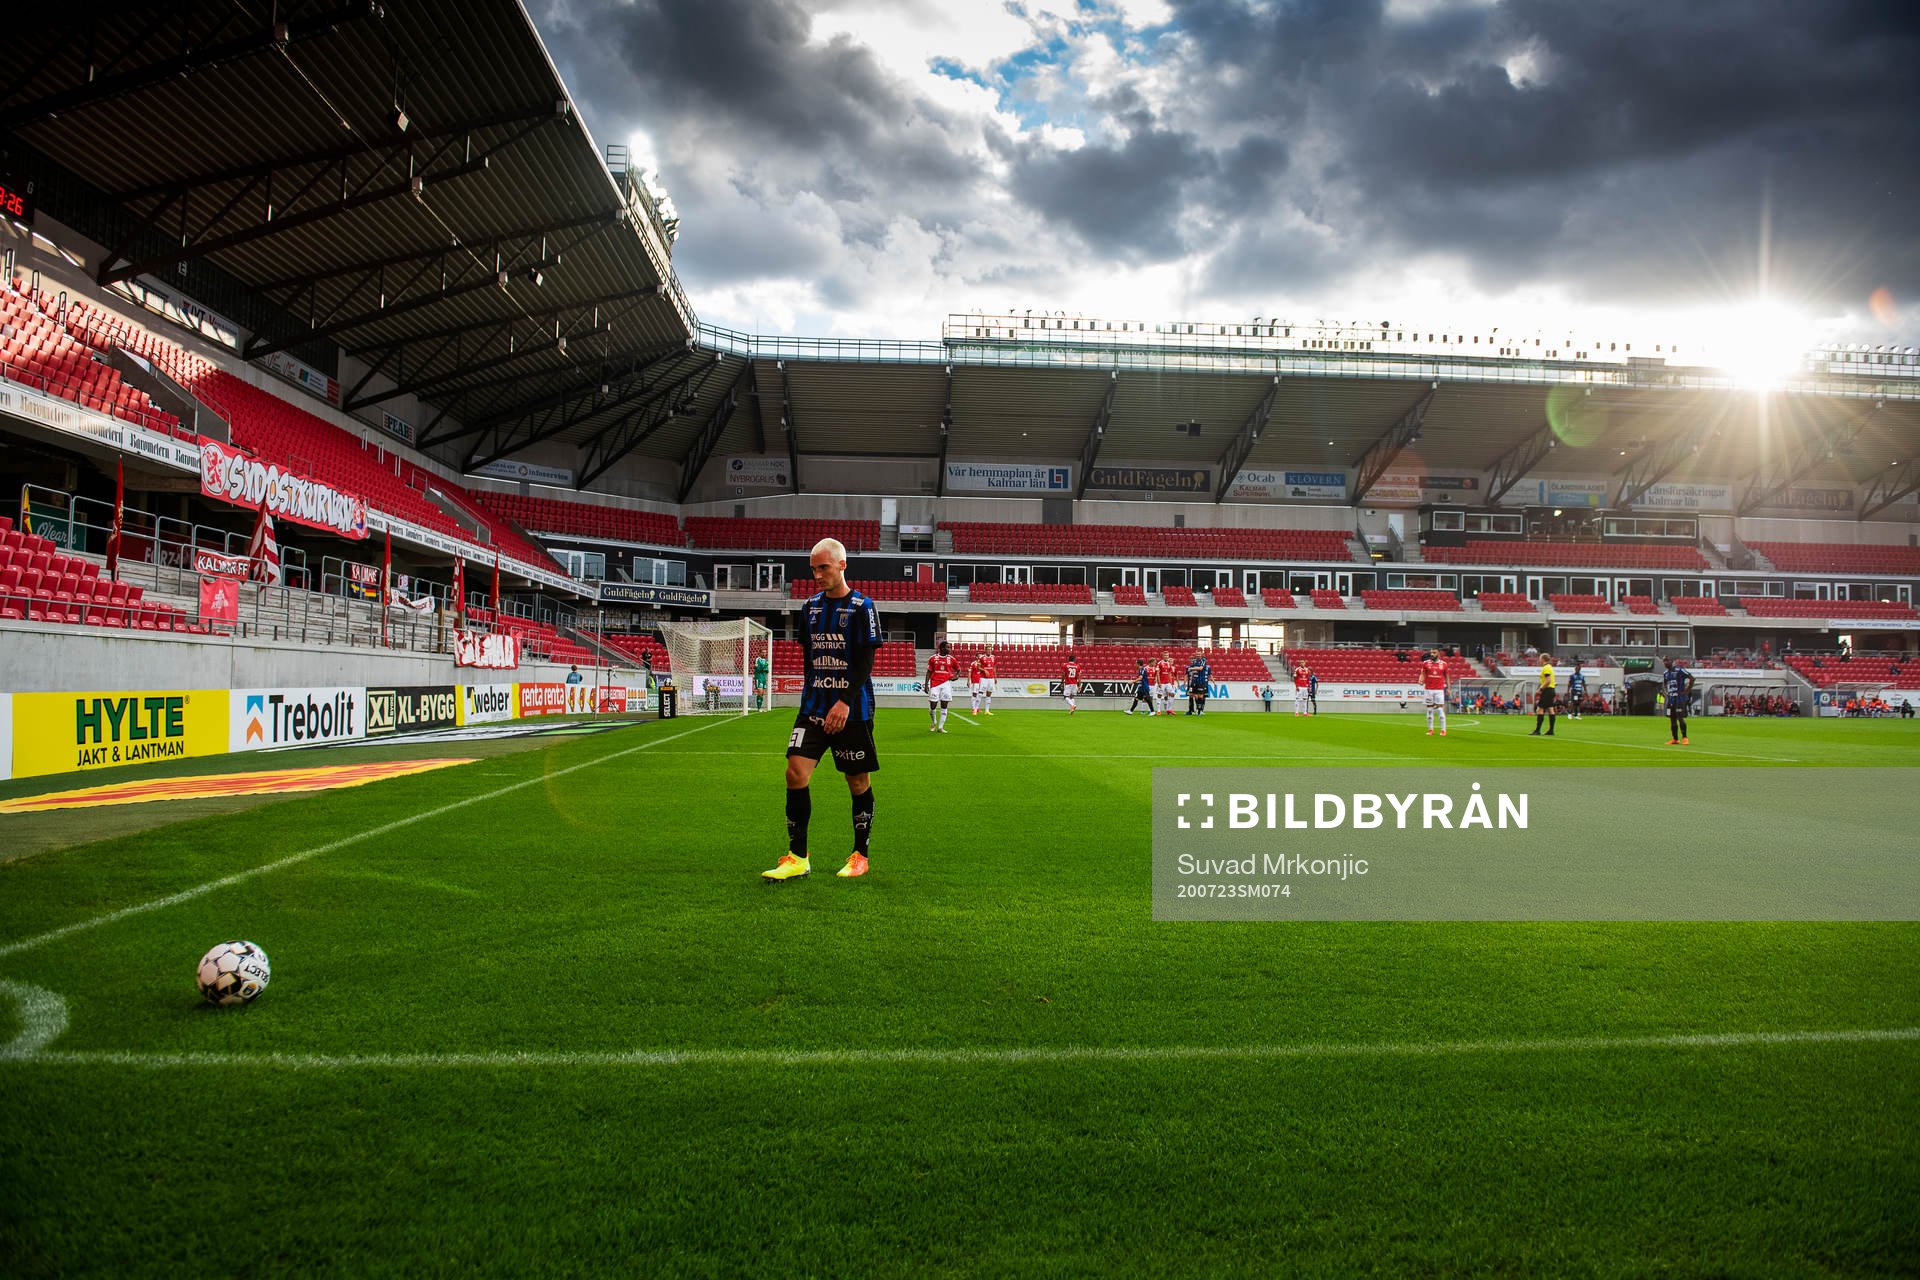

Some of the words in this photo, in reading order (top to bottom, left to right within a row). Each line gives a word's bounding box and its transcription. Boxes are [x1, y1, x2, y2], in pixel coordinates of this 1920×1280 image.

[948, 467, 967, 477] Vår
[969, 467, 1032, 479] hemmaplan
[1034, 469, 1047, 479] är
[988, 477, 1028, 488] Kalmar
[1030, 478, 1046, 488] län
[1091, 469, 1191, 489] GuldFågeln
[1247, 473, 1275, 483] Ocab
[604, 587, 650, 600] GuldFågeln
[659, 591, 703, 604] GuldFågeln
[474, 686, 509, 714] weber
[522, 684, 542, 707] renta
[544, 683, 564, 706] renta
[1052, 682, 1095, 694] ZA
[268, 691, 354, 743] Trebolit
[369, 696, 393, 727] XL
[398, 693, 455, 724] XL-BYGG
[663, 693, 671, 717] SELECT
[76, 696, 184, 745] HYLTE
[77, 747, 108, 767] JAKT
[112, 746, 121, 762] &
[126, 740, 184, 760] LANTMAN
